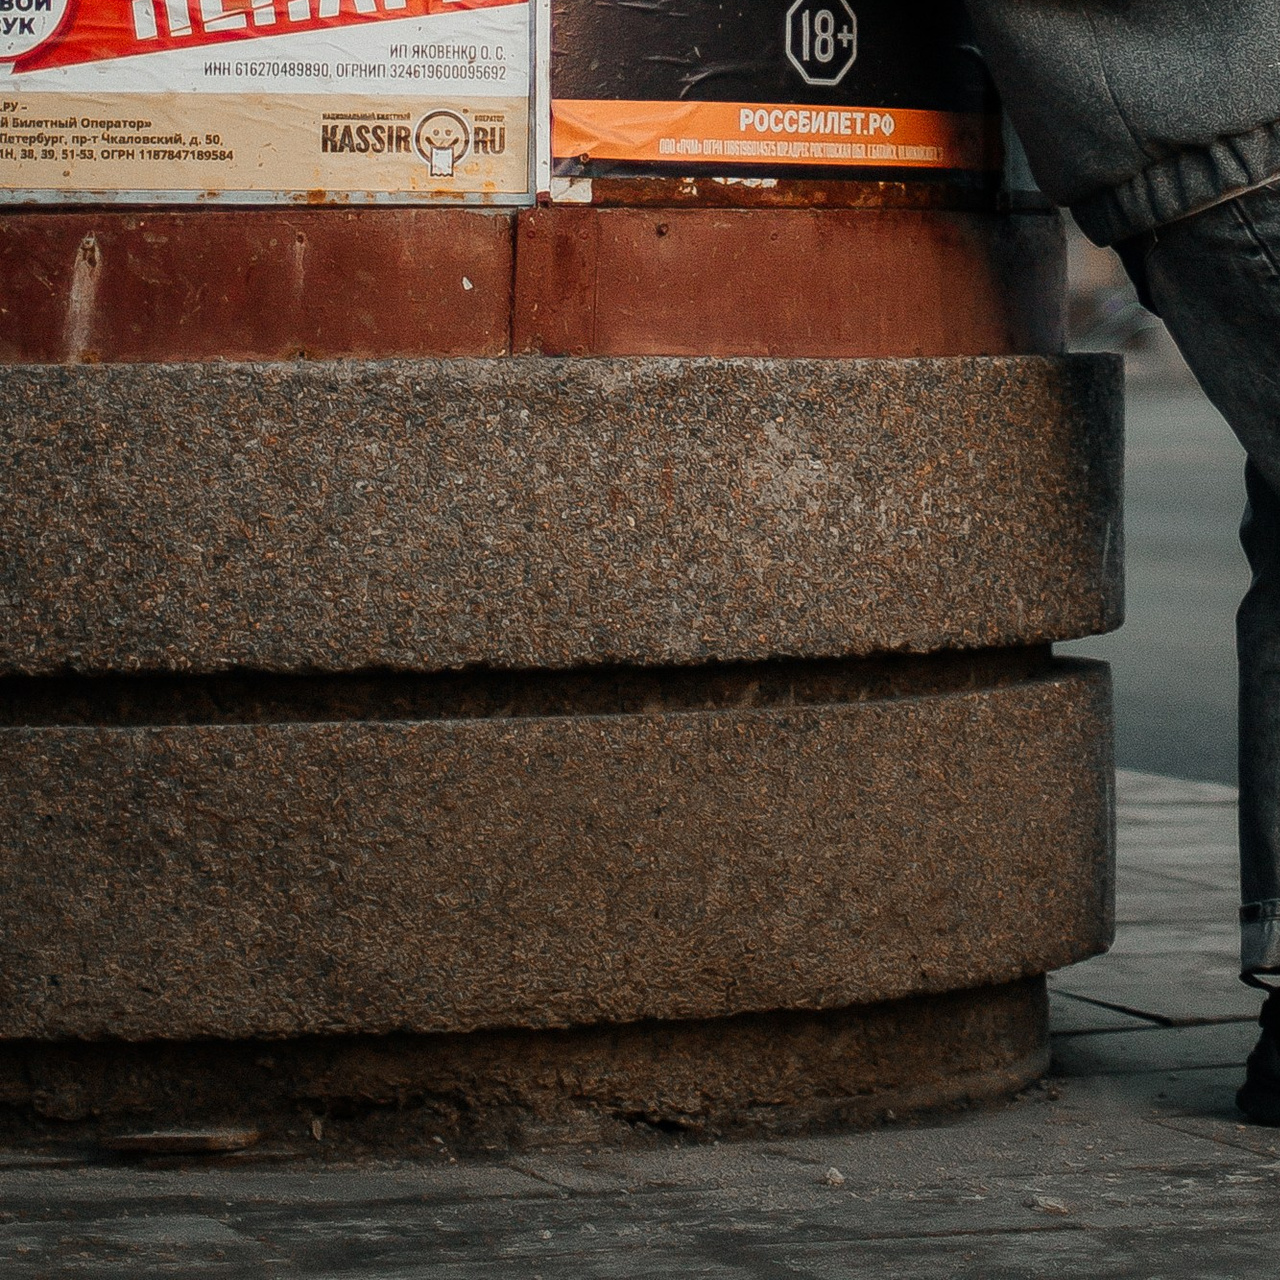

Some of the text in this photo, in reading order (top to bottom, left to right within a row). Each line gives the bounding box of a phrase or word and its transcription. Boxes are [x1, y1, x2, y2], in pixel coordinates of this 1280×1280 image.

[801, 8, 854, 64] 18+
[390, 43, 507, 61] ИП ЯКОВЕНКО О. С.
[204, 62, 507, 80] ИНН 616270489890, ОГРНИП 324619600095692
[12, 116, 78, 129] Билетный
[81, 117, 152, 131] Оператор»
[739, 108, 896, 137] РОССБИЛЕТ.РФ
[71, 135, 99, 147] пр-т
[101, 132, 187, 147] Чкаловский,
[189, 136, 202, 148] д.
[205, 133, 224, 147] 50,
[321, 123, 507, 155] KASSIR RU
[20, 148, 38, 161] 38,
[40, 148, 58, 161] 39,
[61, 148, 97, 162] 51-53,
[101, 149, 135, 161] ОГРН
[139, 149, 234, 162] 1187847189584
